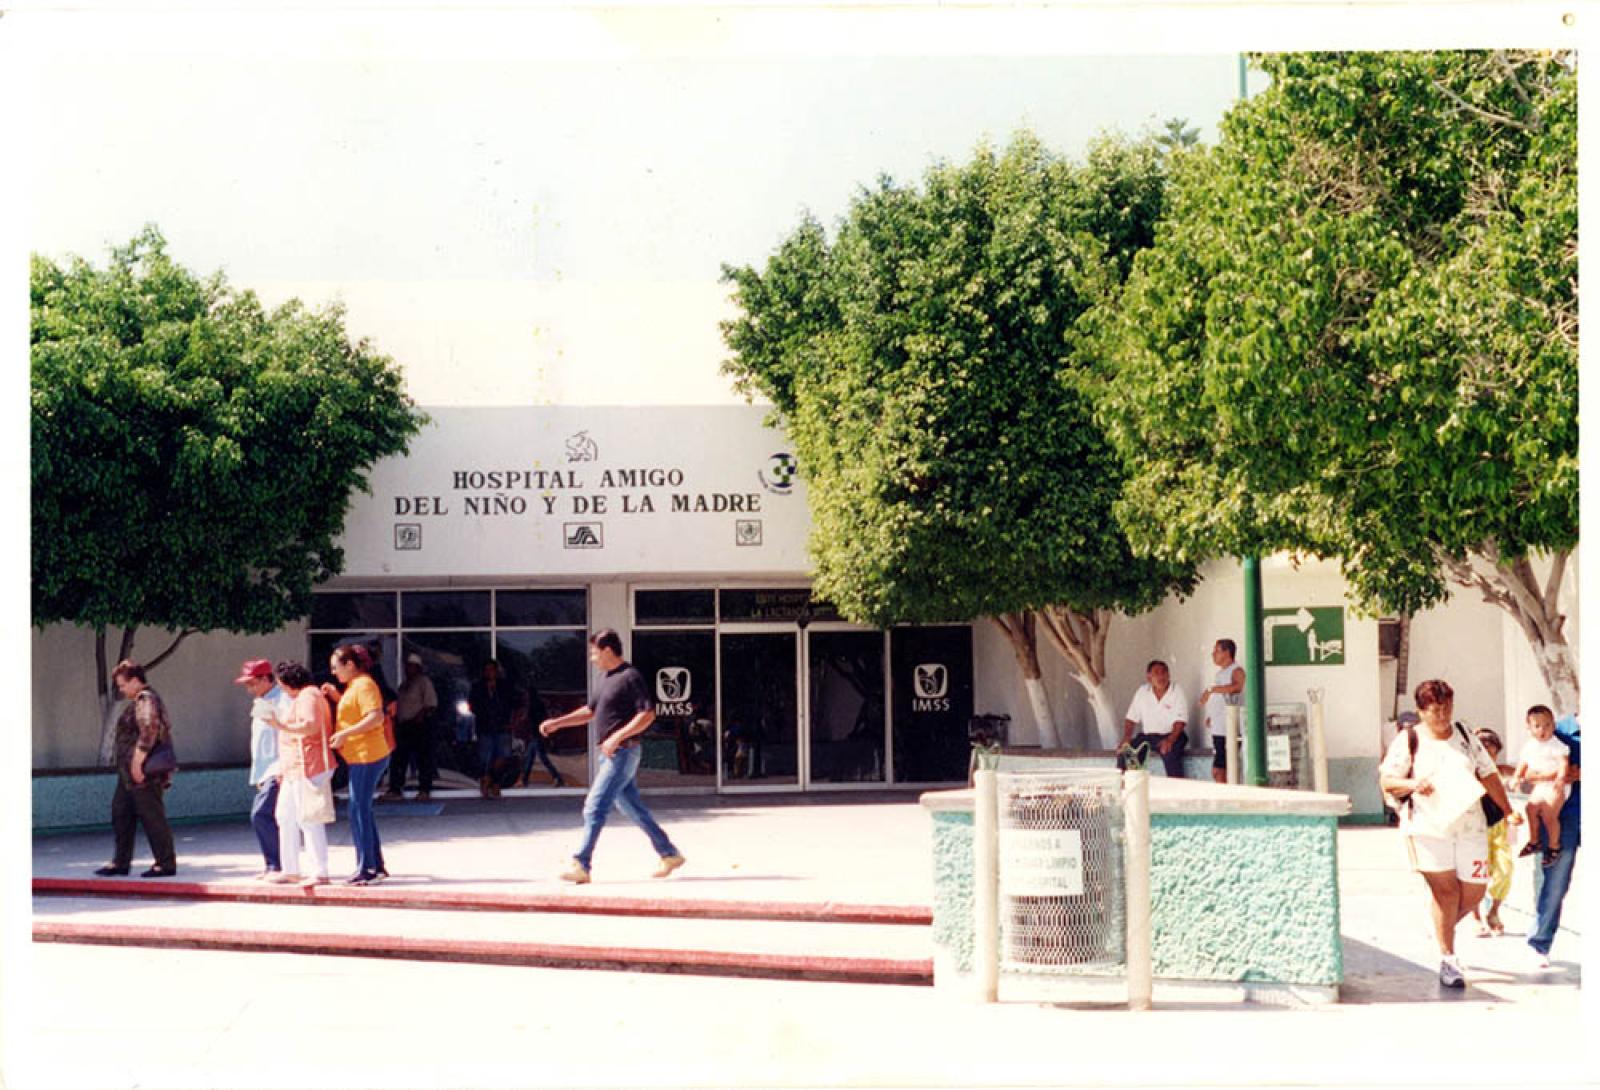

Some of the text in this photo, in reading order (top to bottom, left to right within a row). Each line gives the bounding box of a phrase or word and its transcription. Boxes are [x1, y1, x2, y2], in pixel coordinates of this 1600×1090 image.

[453, 468, 684, 489] HOSPITAL AMIGO
[394, 493, 762, 516] DEL NIÑO Y DE LA MADRE
[655, 702, 693, 716] IMSS
[912, 698, 950, 712] IMSS
